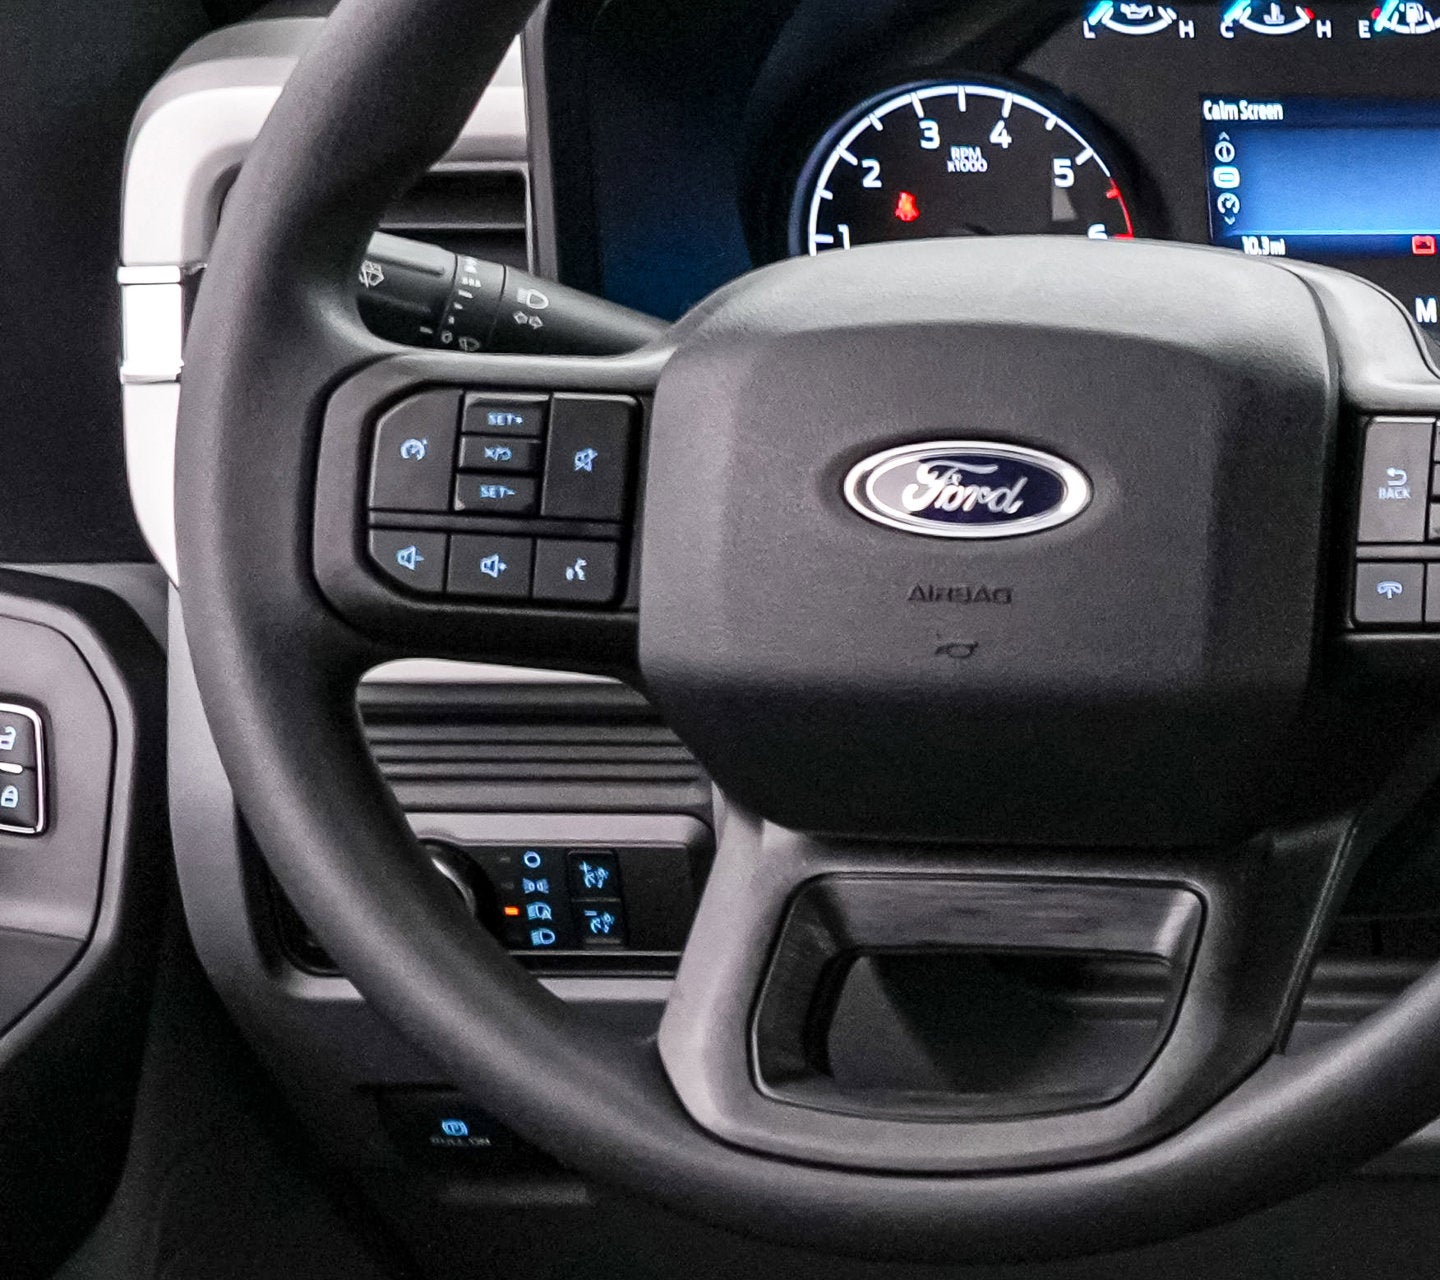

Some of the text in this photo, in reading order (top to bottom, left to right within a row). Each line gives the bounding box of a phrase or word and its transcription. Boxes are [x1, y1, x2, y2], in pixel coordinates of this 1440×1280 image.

[1083, 21, 1195, 39] L H
[1220, 21, 1332, 39] C H
[1358, 22, 1370, 38] E
[1203, 100, 1284, 122] Calm Screen
[919, 121, 940, 150] 3
[988, 121, 1012, 147] 4
[950, 146, 981, 161] RPM
[862, 161, 882, 188] 2
[947, 159, 987, 173] x1000
[1053, 160, 1074, 188] 5
[838, 224, 850, 249] 1
[1415, 297, 1438, 323] M
[901, 458, 1026, 515] Ford
[1378, 487, 1411, 500] BACK
